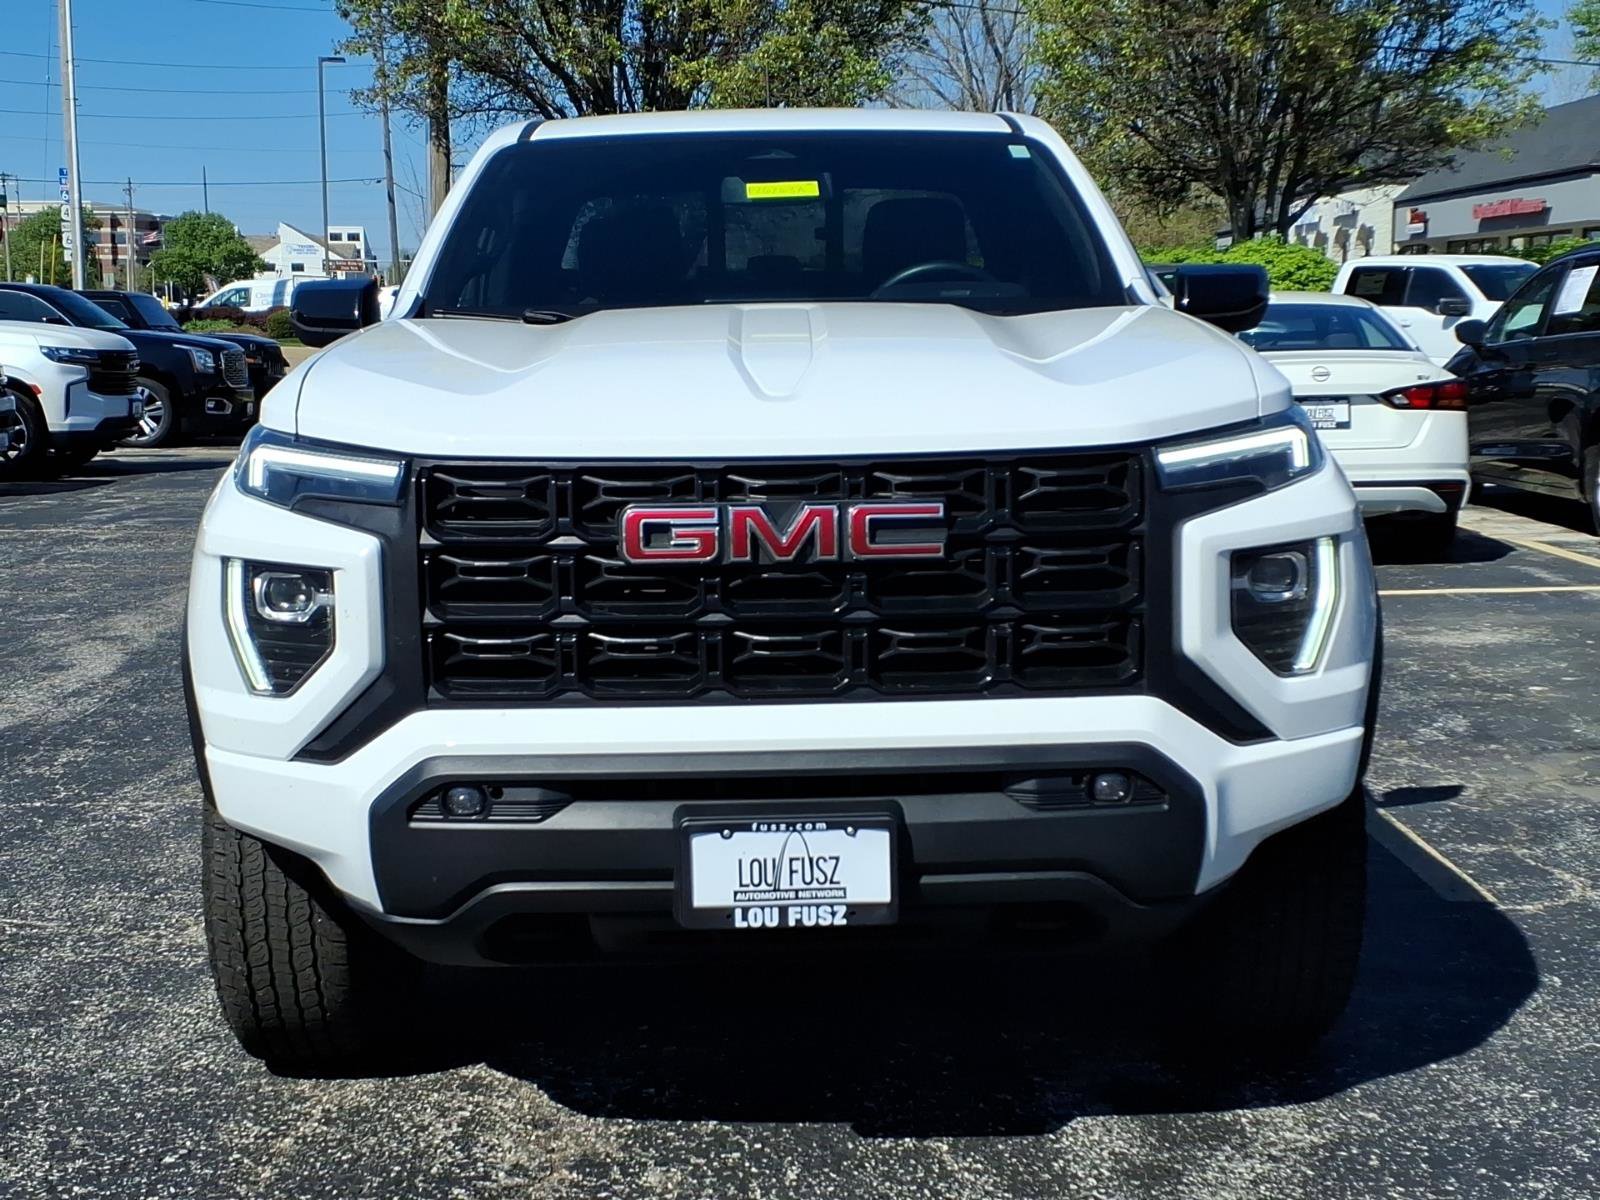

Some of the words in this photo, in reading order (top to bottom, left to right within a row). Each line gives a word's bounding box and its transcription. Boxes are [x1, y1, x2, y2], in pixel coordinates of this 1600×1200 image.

[622, 503, 946, 562] GMC
[752, 822, 828, 832] fusz.com
[738, 857, 777, 888] LOU
[789, 856, 841, 886] FUSZ
[736, 890, 796, 900] AUTOMOTIVE
[798, 889, 846, 899] NETWORK
[734, 907, 779, 928] LOU
[788, 905, 848, 927] FUSZ
